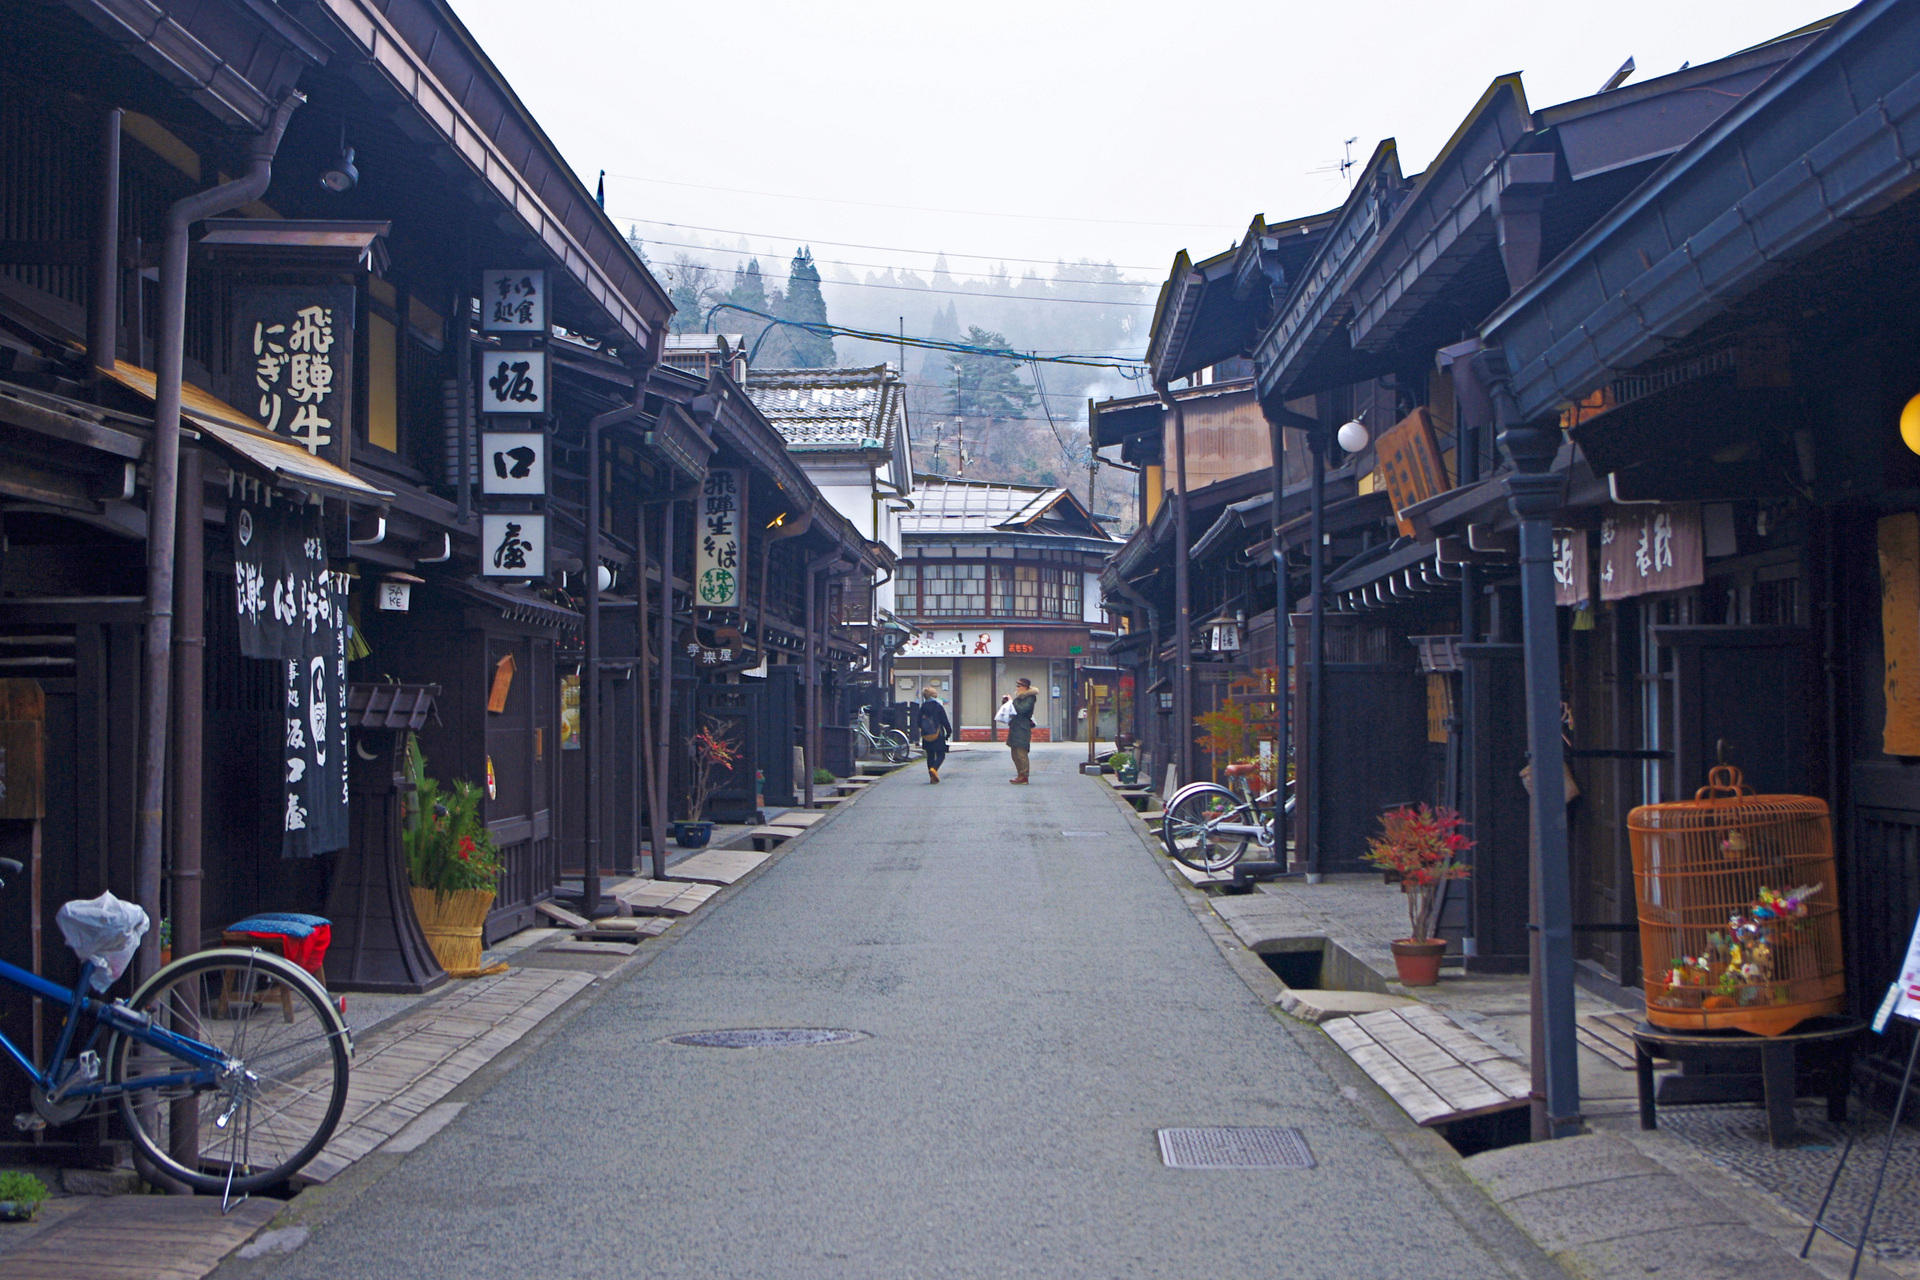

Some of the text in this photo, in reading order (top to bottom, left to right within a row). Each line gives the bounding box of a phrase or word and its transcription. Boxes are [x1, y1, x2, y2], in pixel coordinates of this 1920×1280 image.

[253, 321, 290, 432] にぎり
[287, 305, 335, 456] 飛騨牛
[488, 360, 538, 570] 坂口屋
[388, 586, 403, 597] SA
[389, 596, 402, 607] KE
[1008, 643, 1034, 653] おもちゃ
